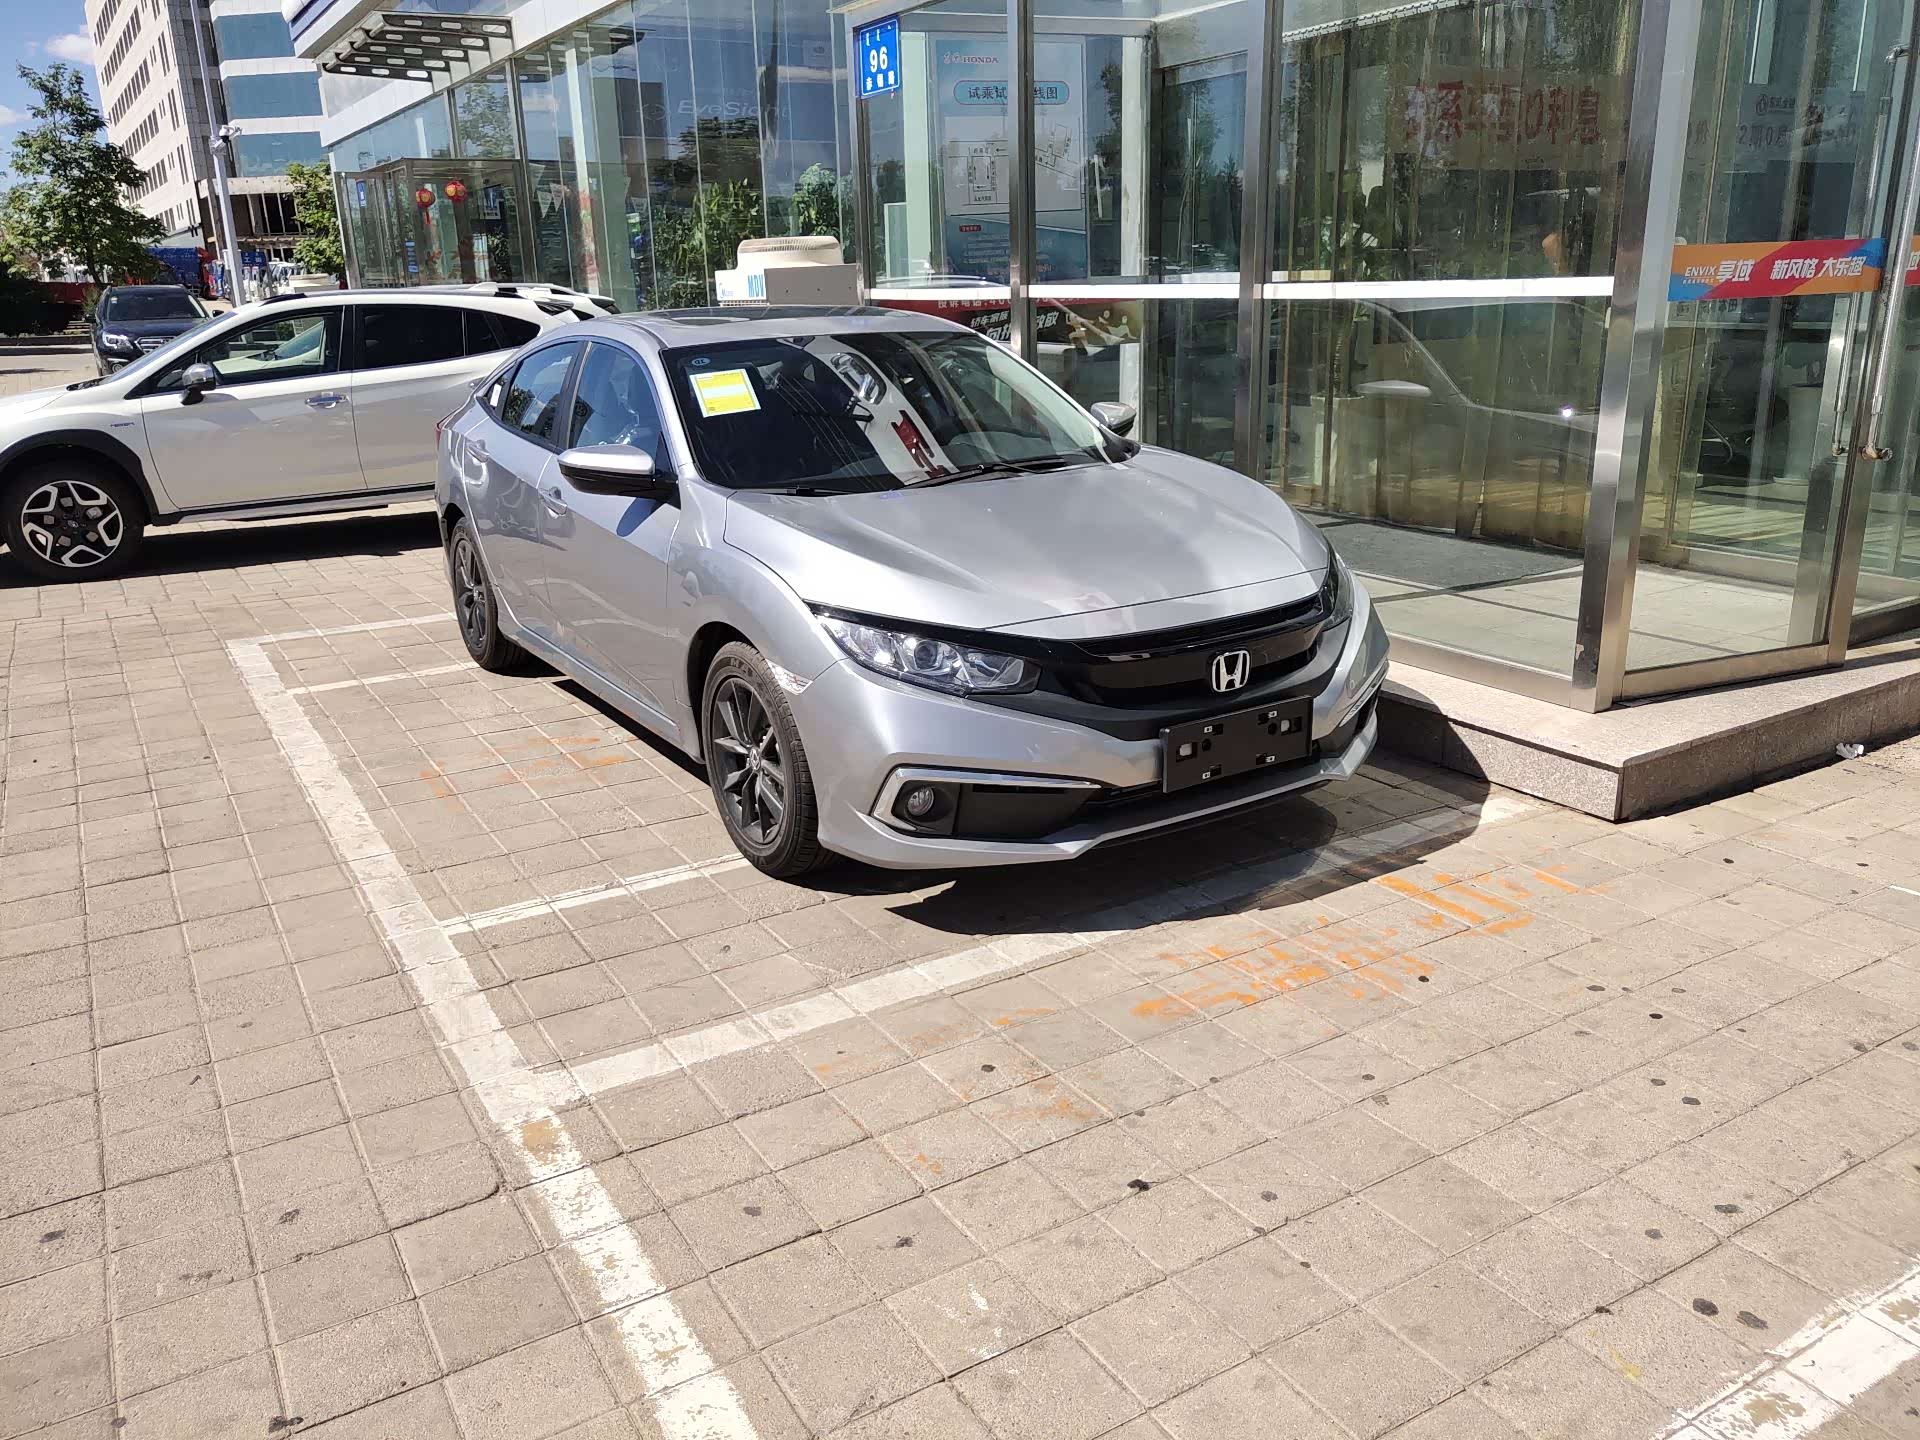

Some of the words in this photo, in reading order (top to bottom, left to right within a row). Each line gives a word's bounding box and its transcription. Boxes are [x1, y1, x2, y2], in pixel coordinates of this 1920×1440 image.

[870, 46, 888, 73] 96
[963, 56, 999, 64] HONDA
[967, 86, 1058, 100] 试乘试线图
[1685, 265, 1717, 277] ENVIX
[1716, 258, 1756, 282] 享域
[1769, 258, 1819, 280] 新风格
[1819, 255, 1867, 278] 大乐趣
[747, 274, 765, 298] MDV
